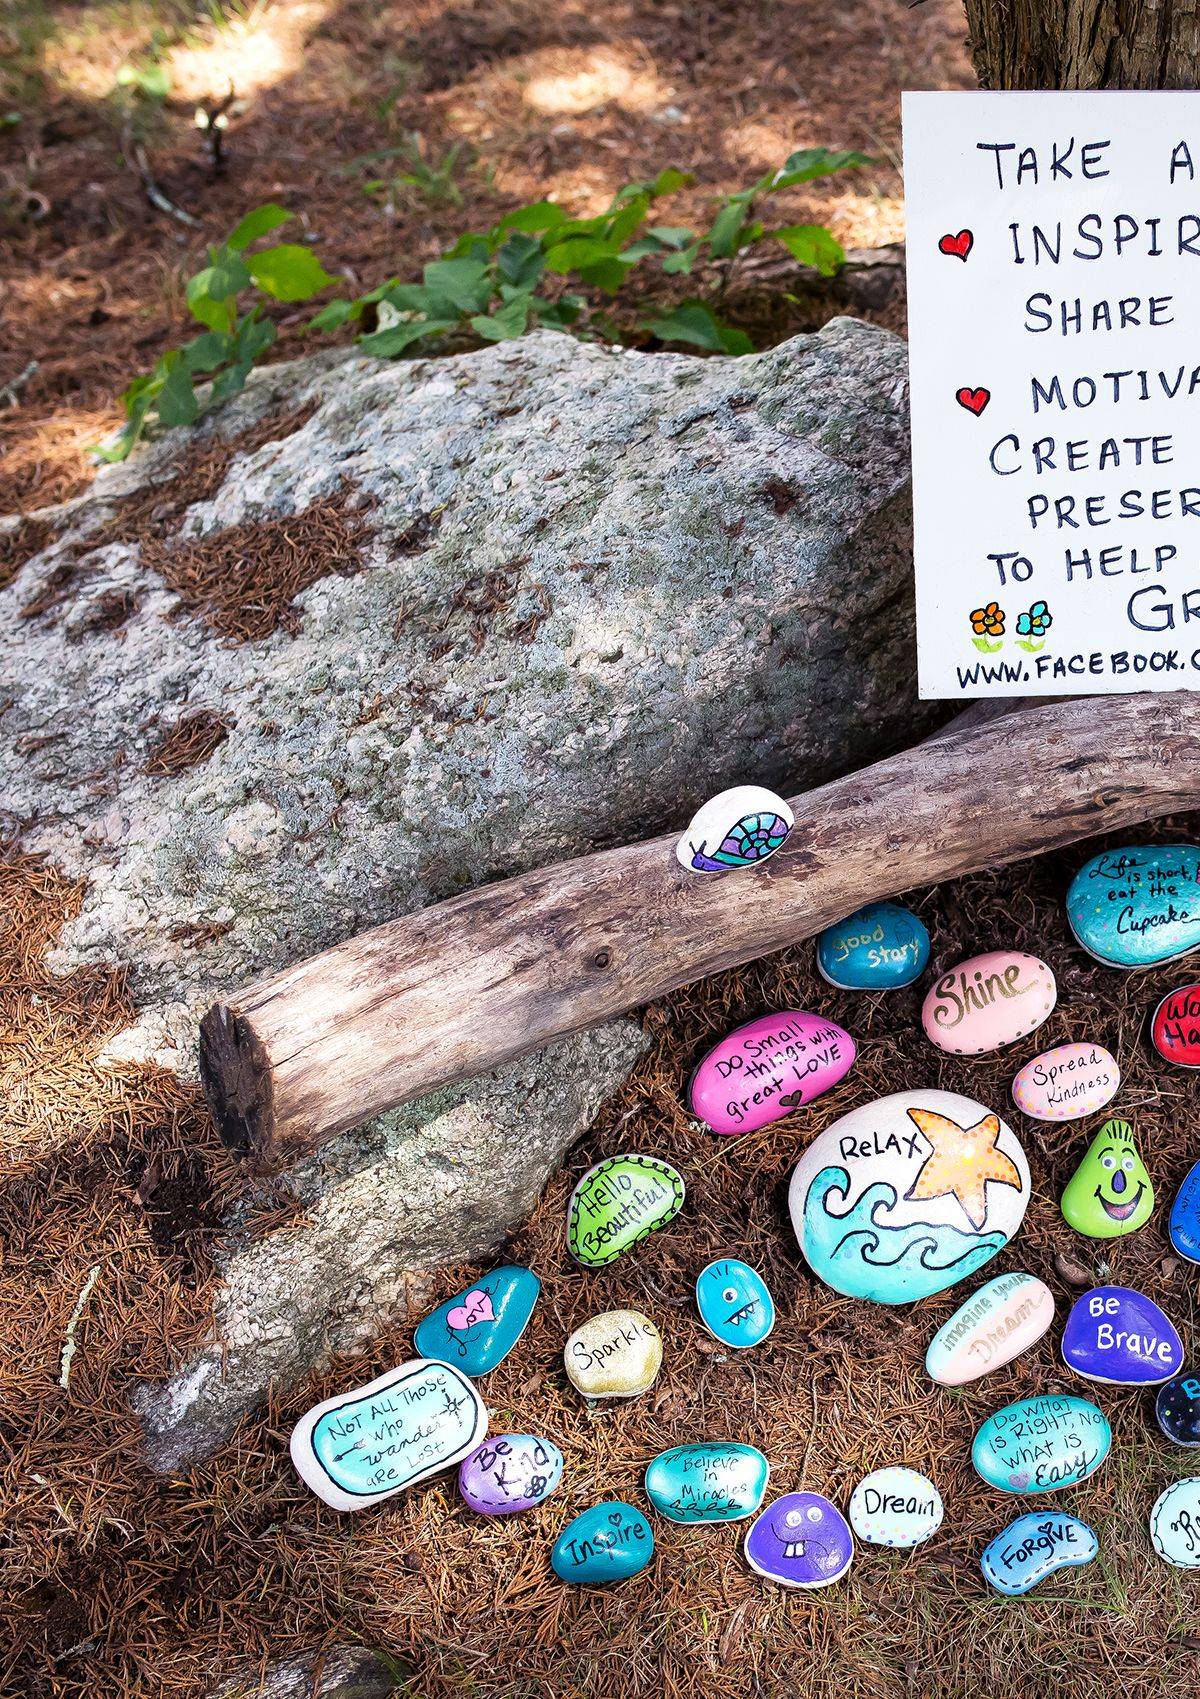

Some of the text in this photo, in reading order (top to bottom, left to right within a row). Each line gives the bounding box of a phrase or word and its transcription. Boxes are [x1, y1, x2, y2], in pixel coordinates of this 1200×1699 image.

[976, 136, 1112, 190] TAKE
[1170, 140, 1195, 184] A
[1024, 292, 1174, 336] SHARE
[989, 433, 1174, 477] CREATE
[987, 552, 1034, 586] TO
[1066, 544, 1178, 581] HELP
[1108, 883, 1178, 901] eat the
[1127, 871, 1141, 883] is
[934, 965, 1038, 1030] Shine
[744, 1020, 804, 1058] Small
[744, 1041, 807, 1079] things
[1033, 1049, 1102, 1086] Spread
[726, 1043, 841, 1123] great LOVE
[581, 1174, 631, 1218] Hello
[583, 1177, 667, 1255] Beautiful
[1089, 1296, 1121, 1318] Be
[573, 1322, 656, 1371] Sparkle
[1097, 1323, 1173, 1363] Brave
[372, 1399, 398, 1420] ALL
[473, 1442, 513, 1471] Be
[704, 1468, 718, 1481] in
[1036, 1449, 1098, 1487] Easy
[564, 1522, 646, 1566] Inspire
